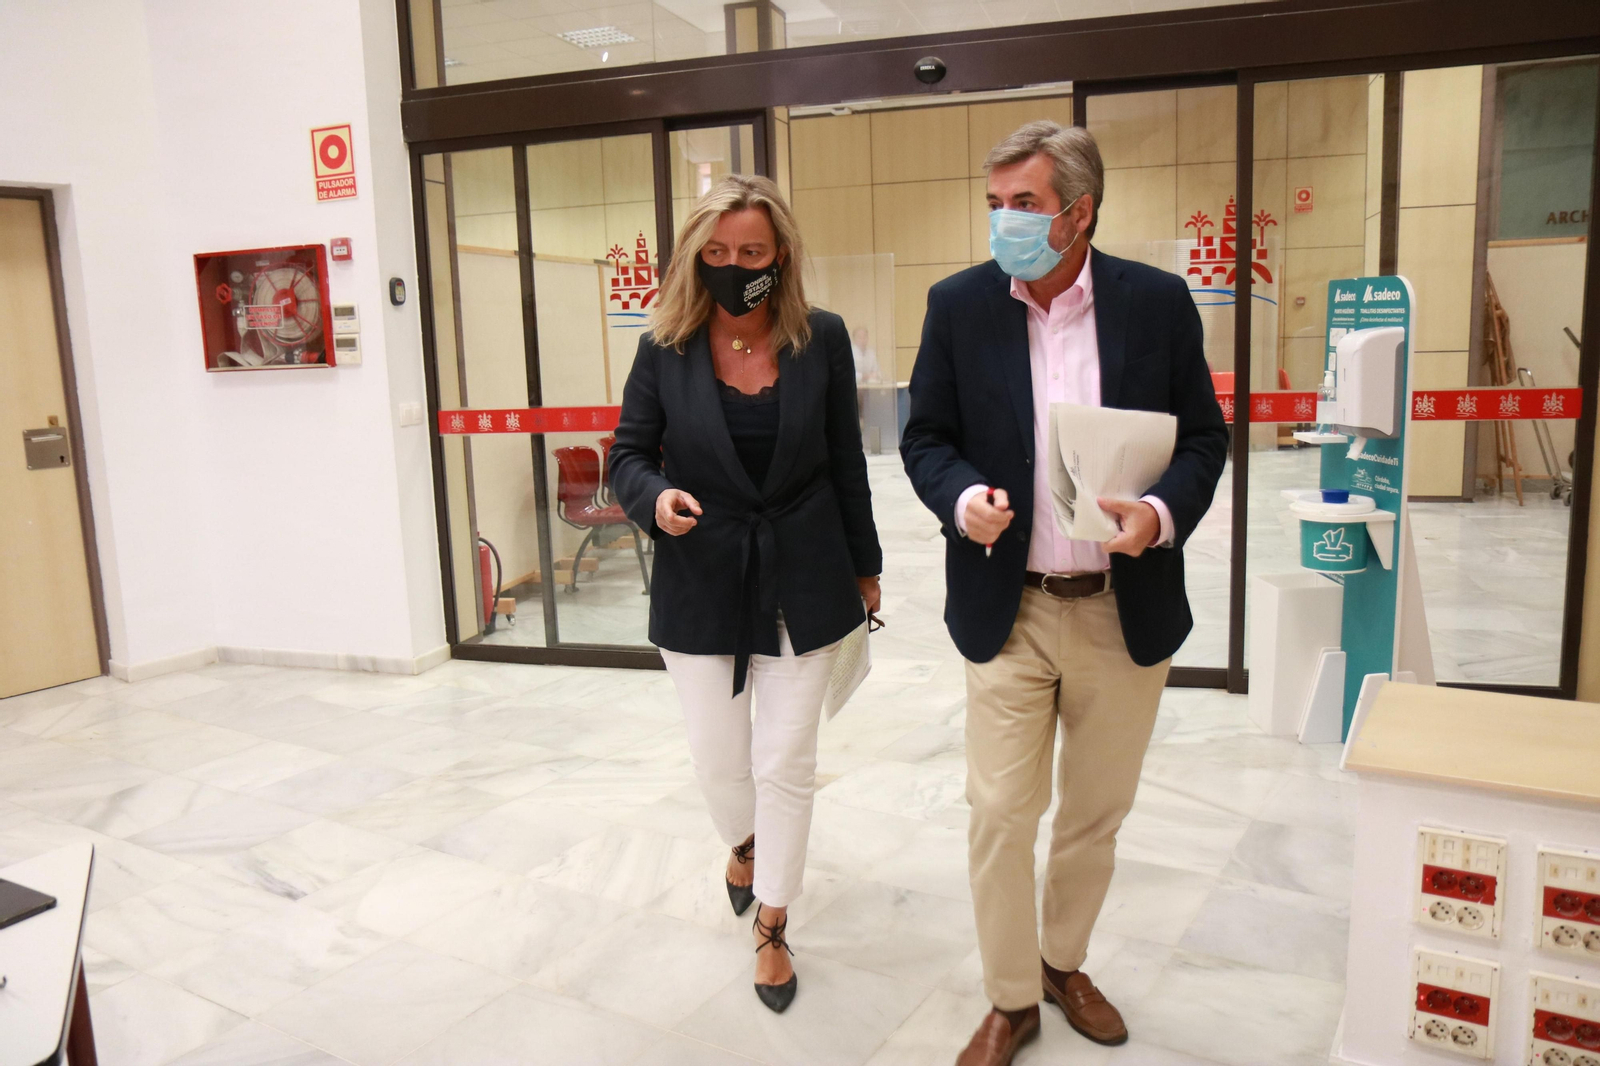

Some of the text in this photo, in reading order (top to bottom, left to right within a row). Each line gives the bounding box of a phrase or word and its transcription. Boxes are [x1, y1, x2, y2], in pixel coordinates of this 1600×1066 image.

[318, 178, 354, 189] PULSADOR
[318, 187, 356, 199] DE ALARMA
[1373, 287, 1401, 300] sadeco
